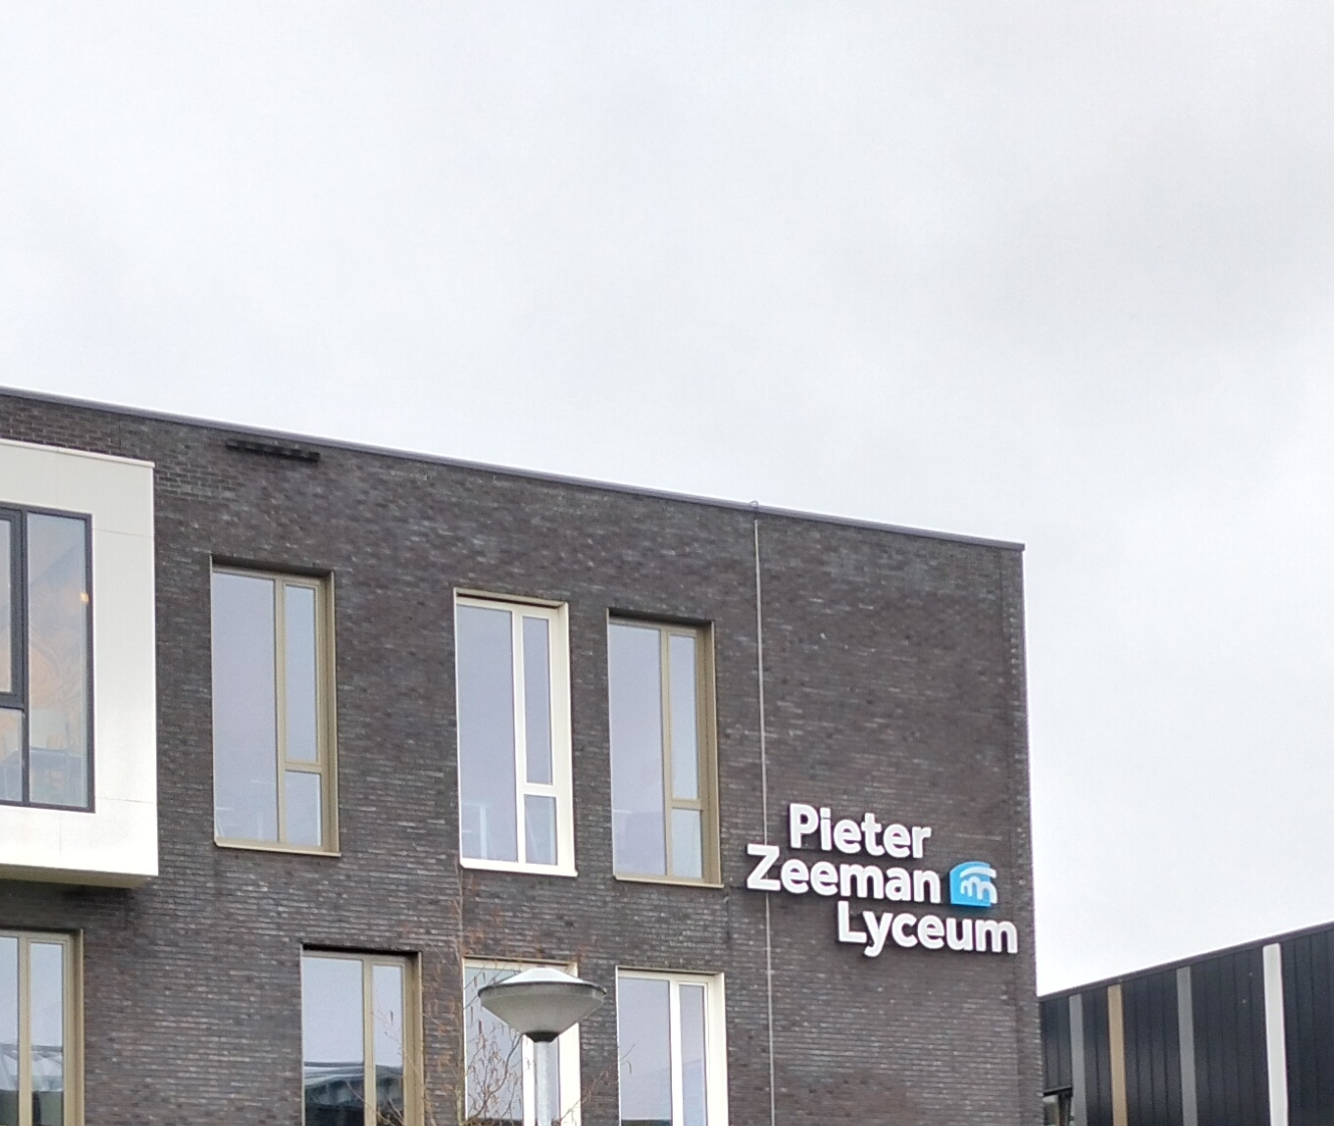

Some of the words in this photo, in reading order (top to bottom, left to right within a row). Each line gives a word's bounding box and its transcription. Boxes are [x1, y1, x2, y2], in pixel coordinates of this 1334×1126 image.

[788, 802, 932, 858] Pieter
[746, 843, 942, 904] Zeeman
[837, 900, 1019, 957] Lyceum
